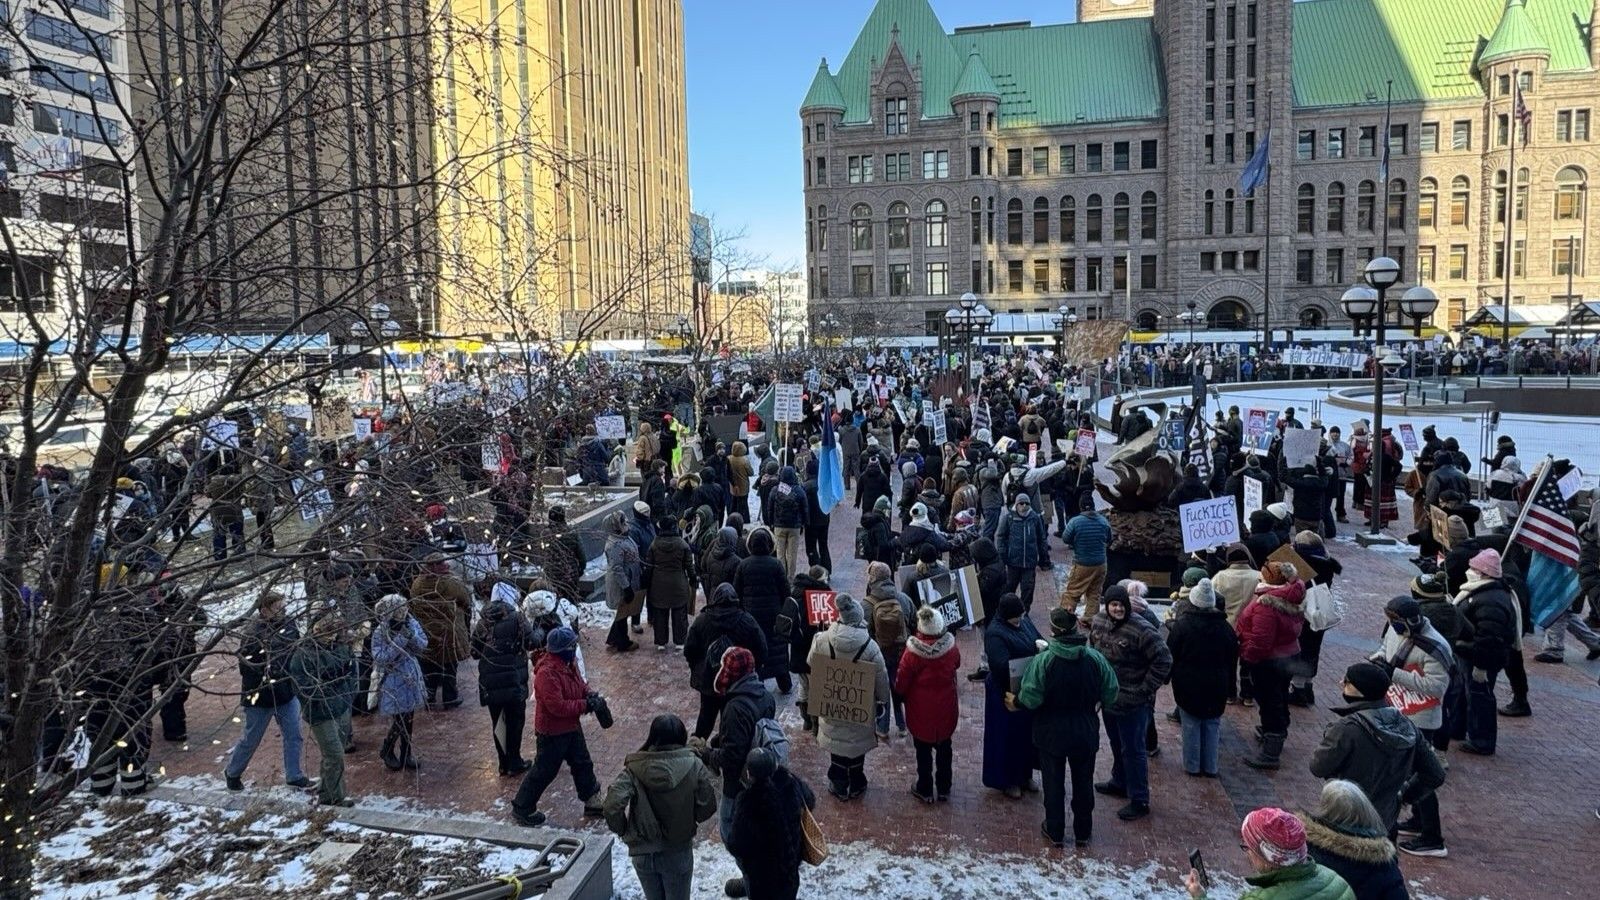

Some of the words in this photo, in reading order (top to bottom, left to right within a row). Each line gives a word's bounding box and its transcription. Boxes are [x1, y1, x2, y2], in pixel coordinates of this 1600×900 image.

[1159, 436, 1184, 449] OT
[1206, 519, 1235, 538] GOOD
[810, 592, 835, 611] FUCK
[944, 598, 960, 615] ONE
[812, 611, 836, 625] ICE
[826, 666, 867, 687] DON'T
[823, 684, 867, 705] SHOOT
[820, 701, 869, 723] UNARMED
